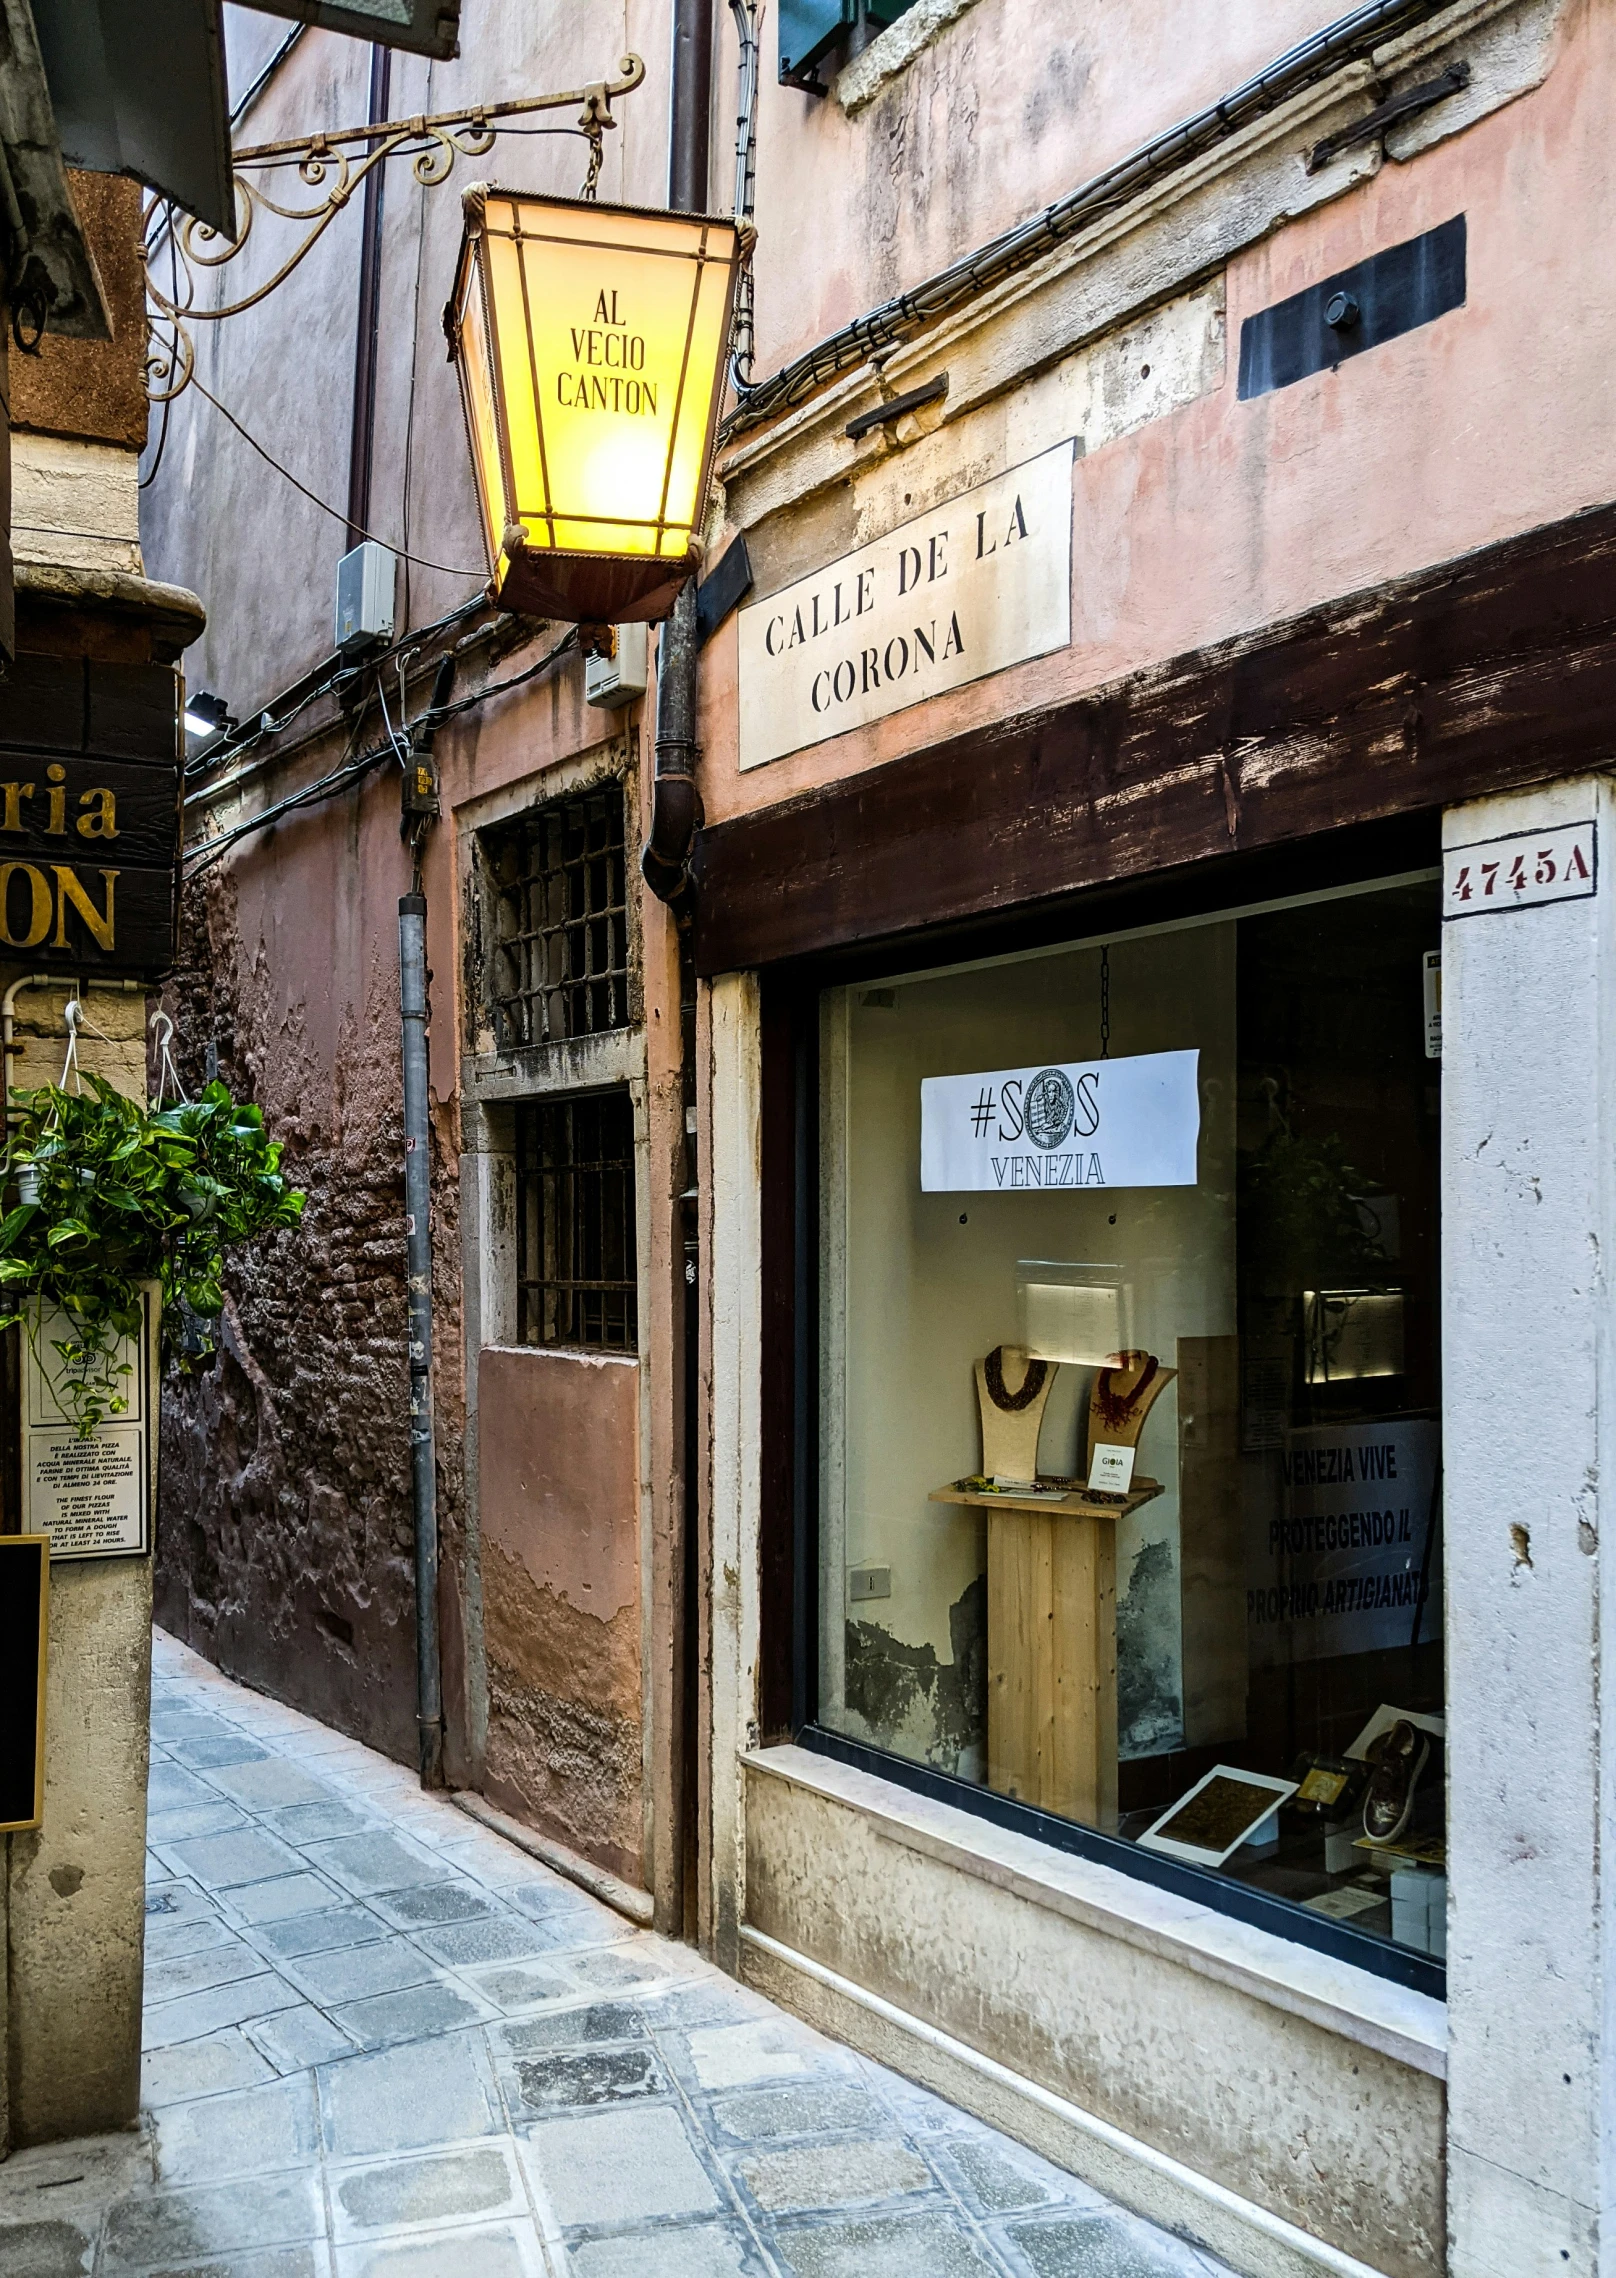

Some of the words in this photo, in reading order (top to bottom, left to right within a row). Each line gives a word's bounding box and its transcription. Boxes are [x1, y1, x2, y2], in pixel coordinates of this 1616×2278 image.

[593, 288, 626, 326] AL
[570, 328, 645, 371] VECIO
[557, 372, 657, 416] CANTON
[765, 567, 875, 656] CALLE
[898, 531, 948, 597] DE
[975, 494, 1029, 560] LA
[811, 610, 965, 713] CORONA
[1452, 845, 1591, 901] 4745A
[991, 1153, 1105, 1187] VENEZIA
[1282, 1448, 1354, 1486] VENEZIA
[1358, 1445, 1397, 1481] VIVE
[1269, 1510, 1395, 1554] PROTEGGENDO
[1399, 1508, 1411, 1542] IL
[1247, 1581, 1318, 1624] PROPRIO
